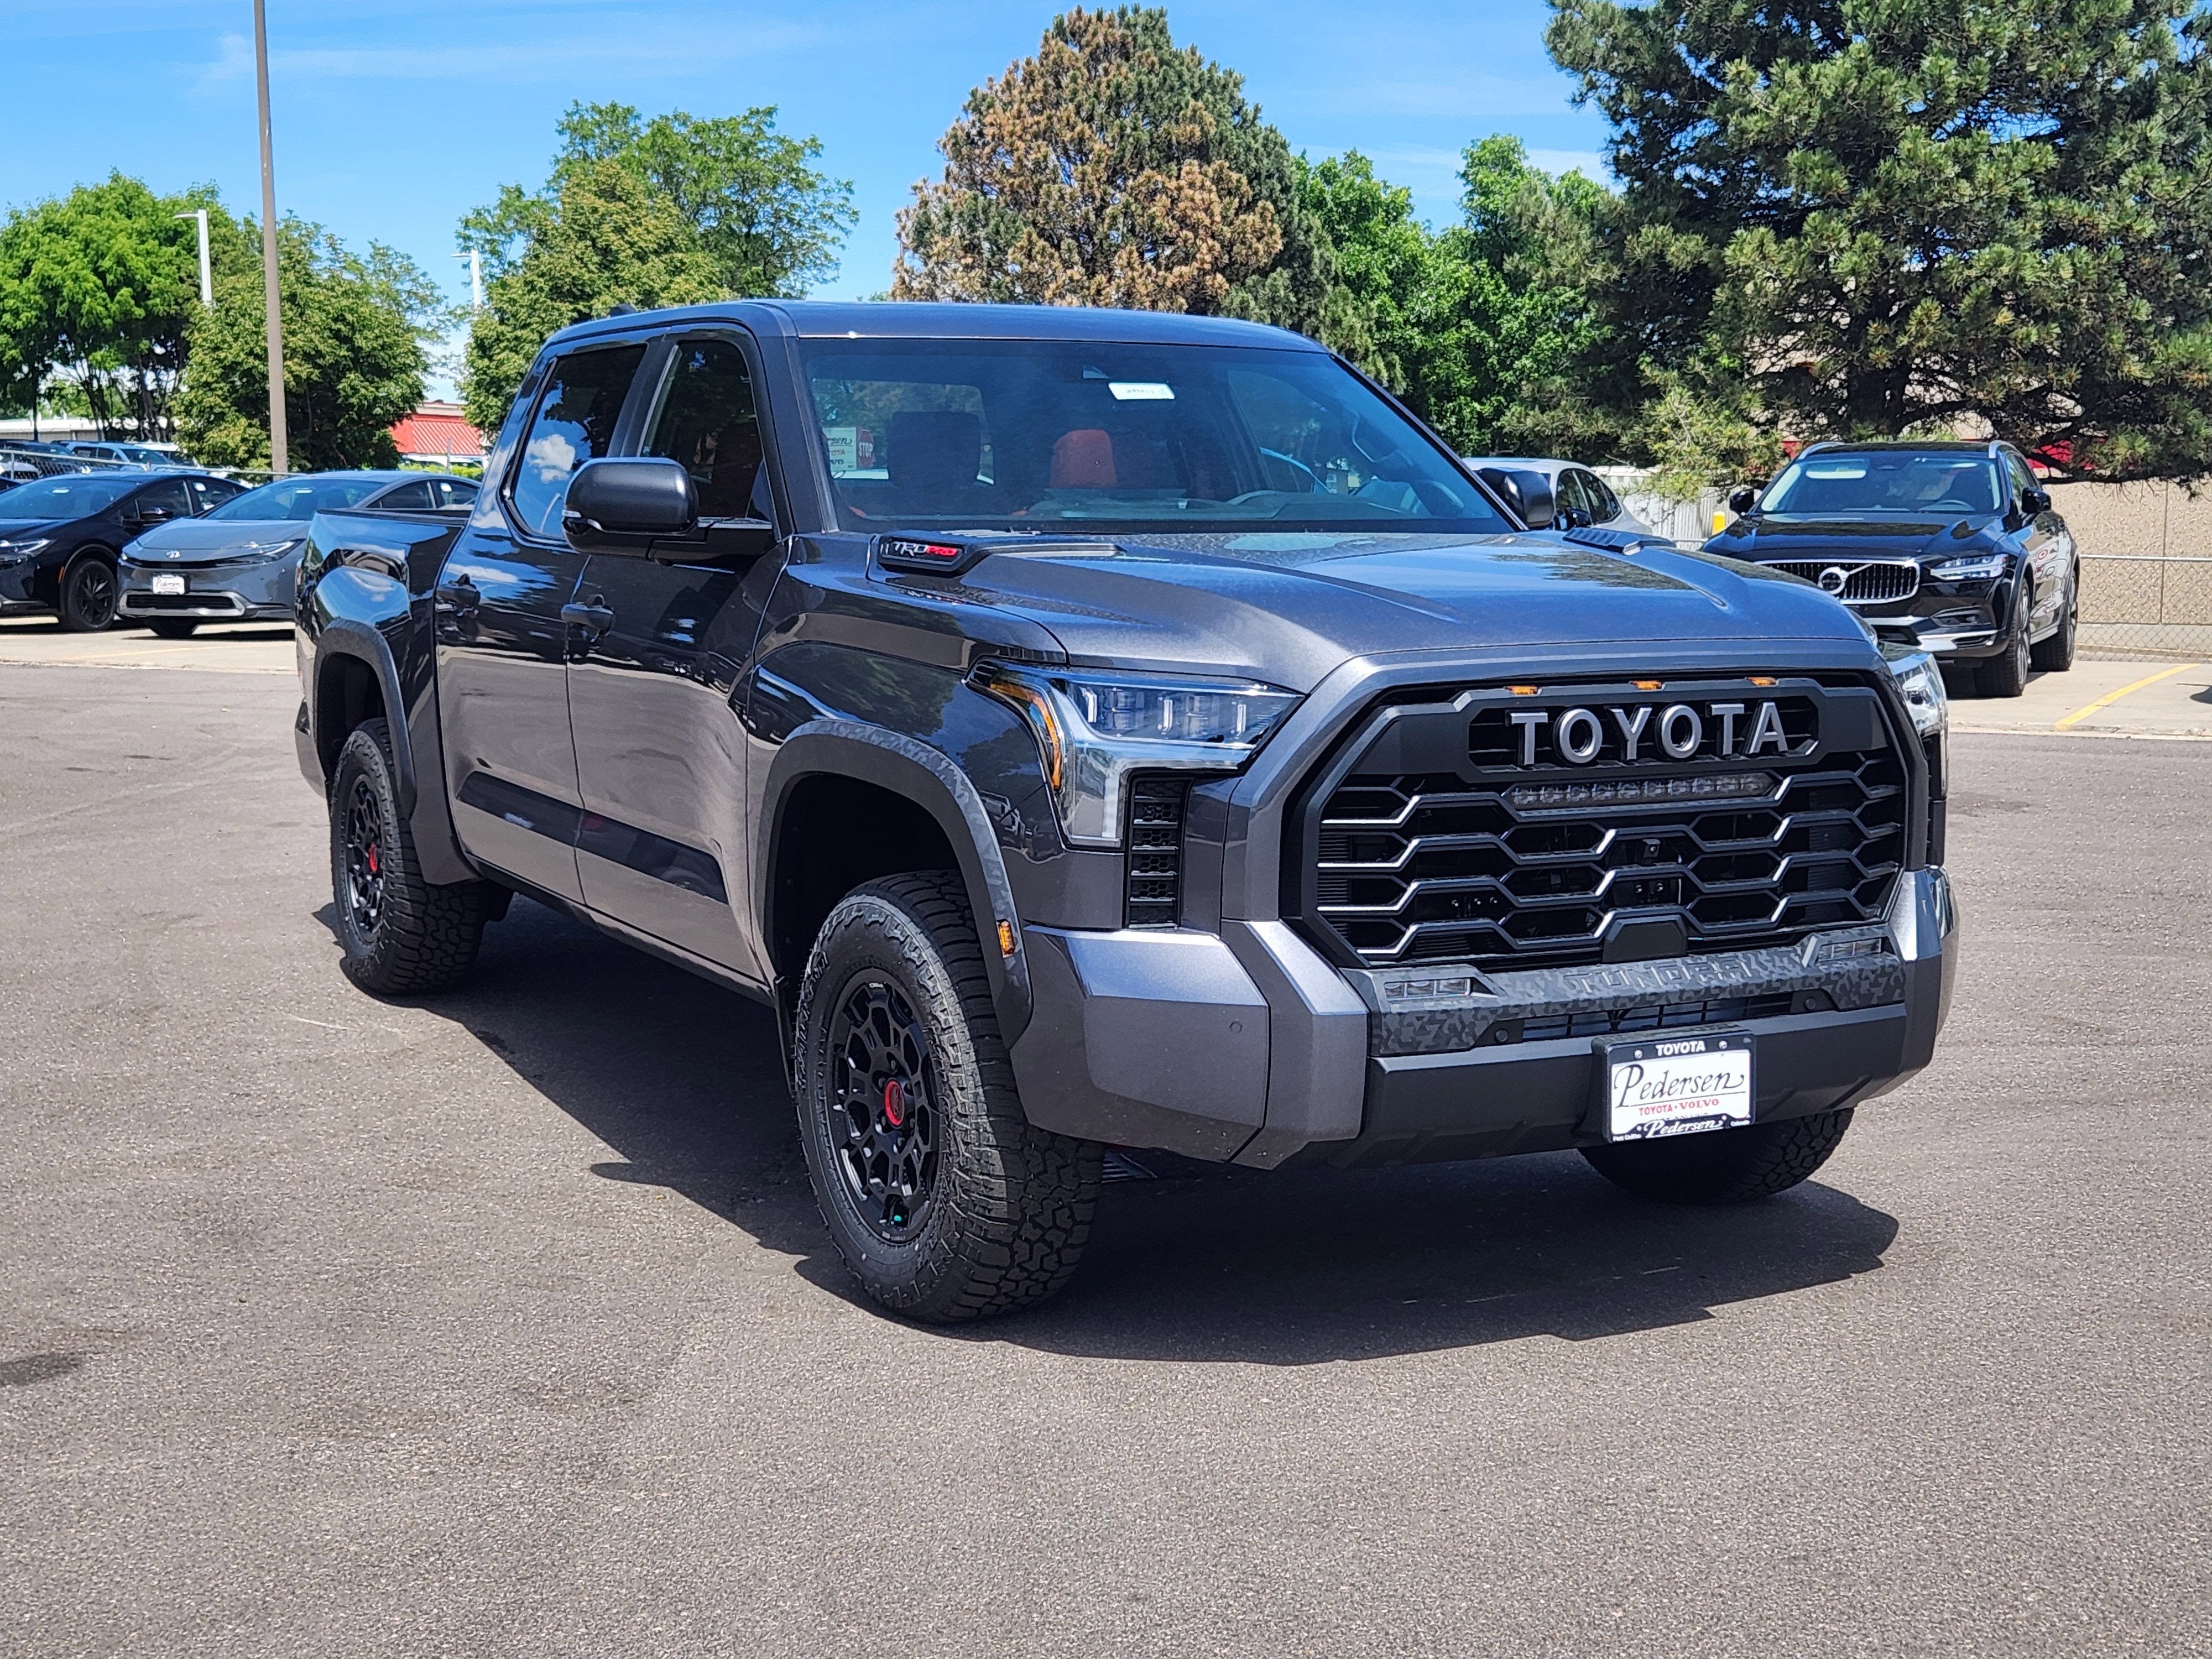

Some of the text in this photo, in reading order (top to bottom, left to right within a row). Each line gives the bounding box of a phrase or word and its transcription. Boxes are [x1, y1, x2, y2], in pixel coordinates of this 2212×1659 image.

[858, 441, 874, 458] STOP
[1506, 701, 1788, 766] TOYOTA
[1563, 958, 1752, 994] TUNDRA
[1655, 1040, 1706, 1056] TOYOTA
[1614, 1064, 1745, 1109] Pedersen
[1639, 1098, 1719, 1116] TOYOTA VOLVO
[1643, 1119, 1724, 1139] Pedersen
